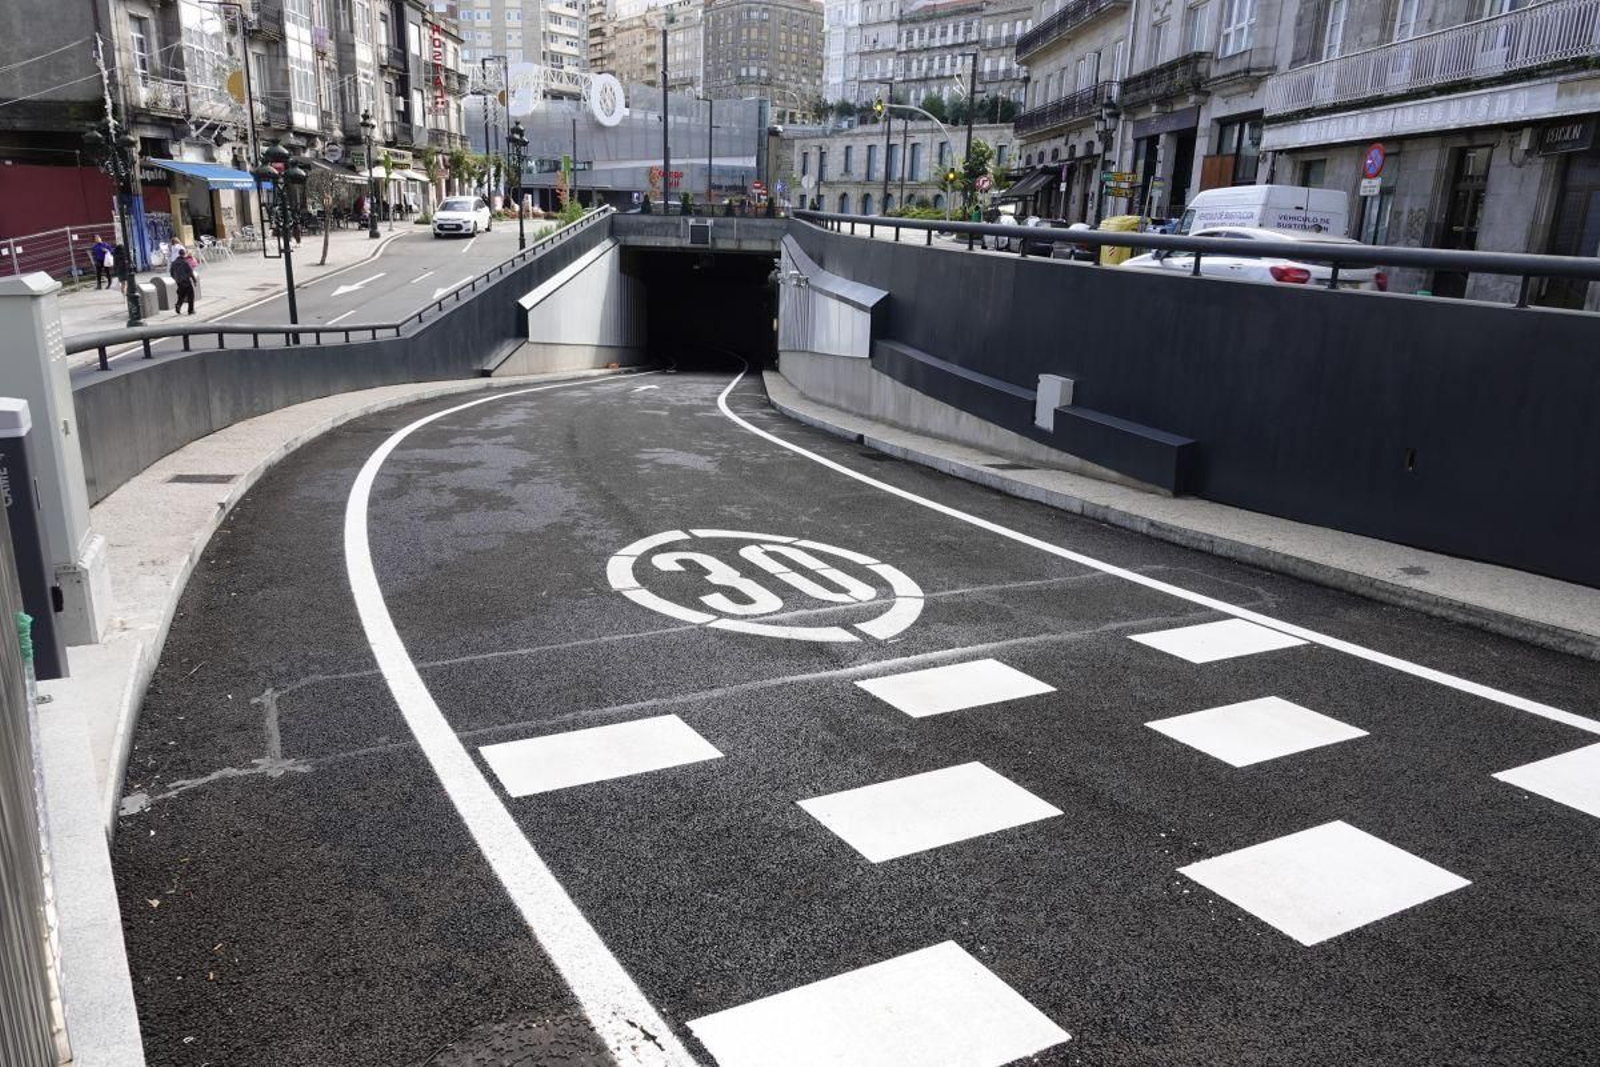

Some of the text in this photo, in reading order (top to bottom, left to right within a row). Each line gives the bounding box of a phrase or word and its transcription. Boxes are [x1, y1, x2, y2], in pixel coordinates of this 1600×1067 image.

[432, 25, 444, 98] HOSTAL
[1278, 214, 1319, 224] VEHICULO
[651, 544, 877, 615] 30
